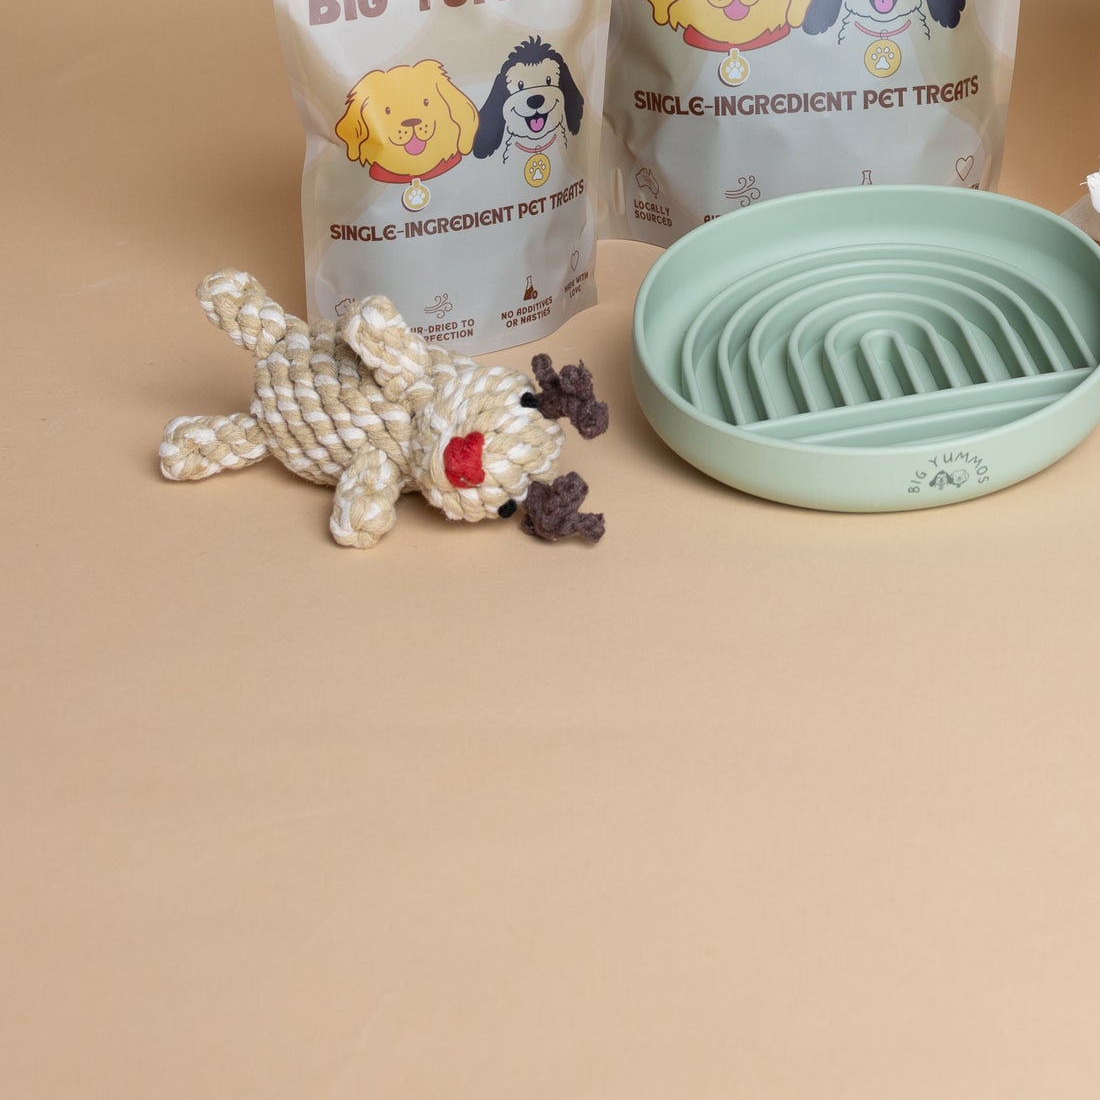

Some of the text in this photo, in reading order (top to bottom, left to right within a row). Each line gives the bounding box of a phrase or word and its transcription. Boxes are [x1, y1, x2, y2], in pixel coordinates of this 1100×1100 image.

[634, 75, 979, 117] SINGLE-INGREDIENT PET TREATS
[330, 178, 584, 242] SINGLE-INGREDIENT PET TREATS
[634, 199, 670, 216] LOCALLY
[634, 210, 673, 227] SOURCED
[501, 296, 553, 320] NO ADDITIVES
[506, 307, 551, 328] OR NASTIES
[461, 318, 475, 328] TO
[908, 452, 989, 493] BIG YUMMOS
